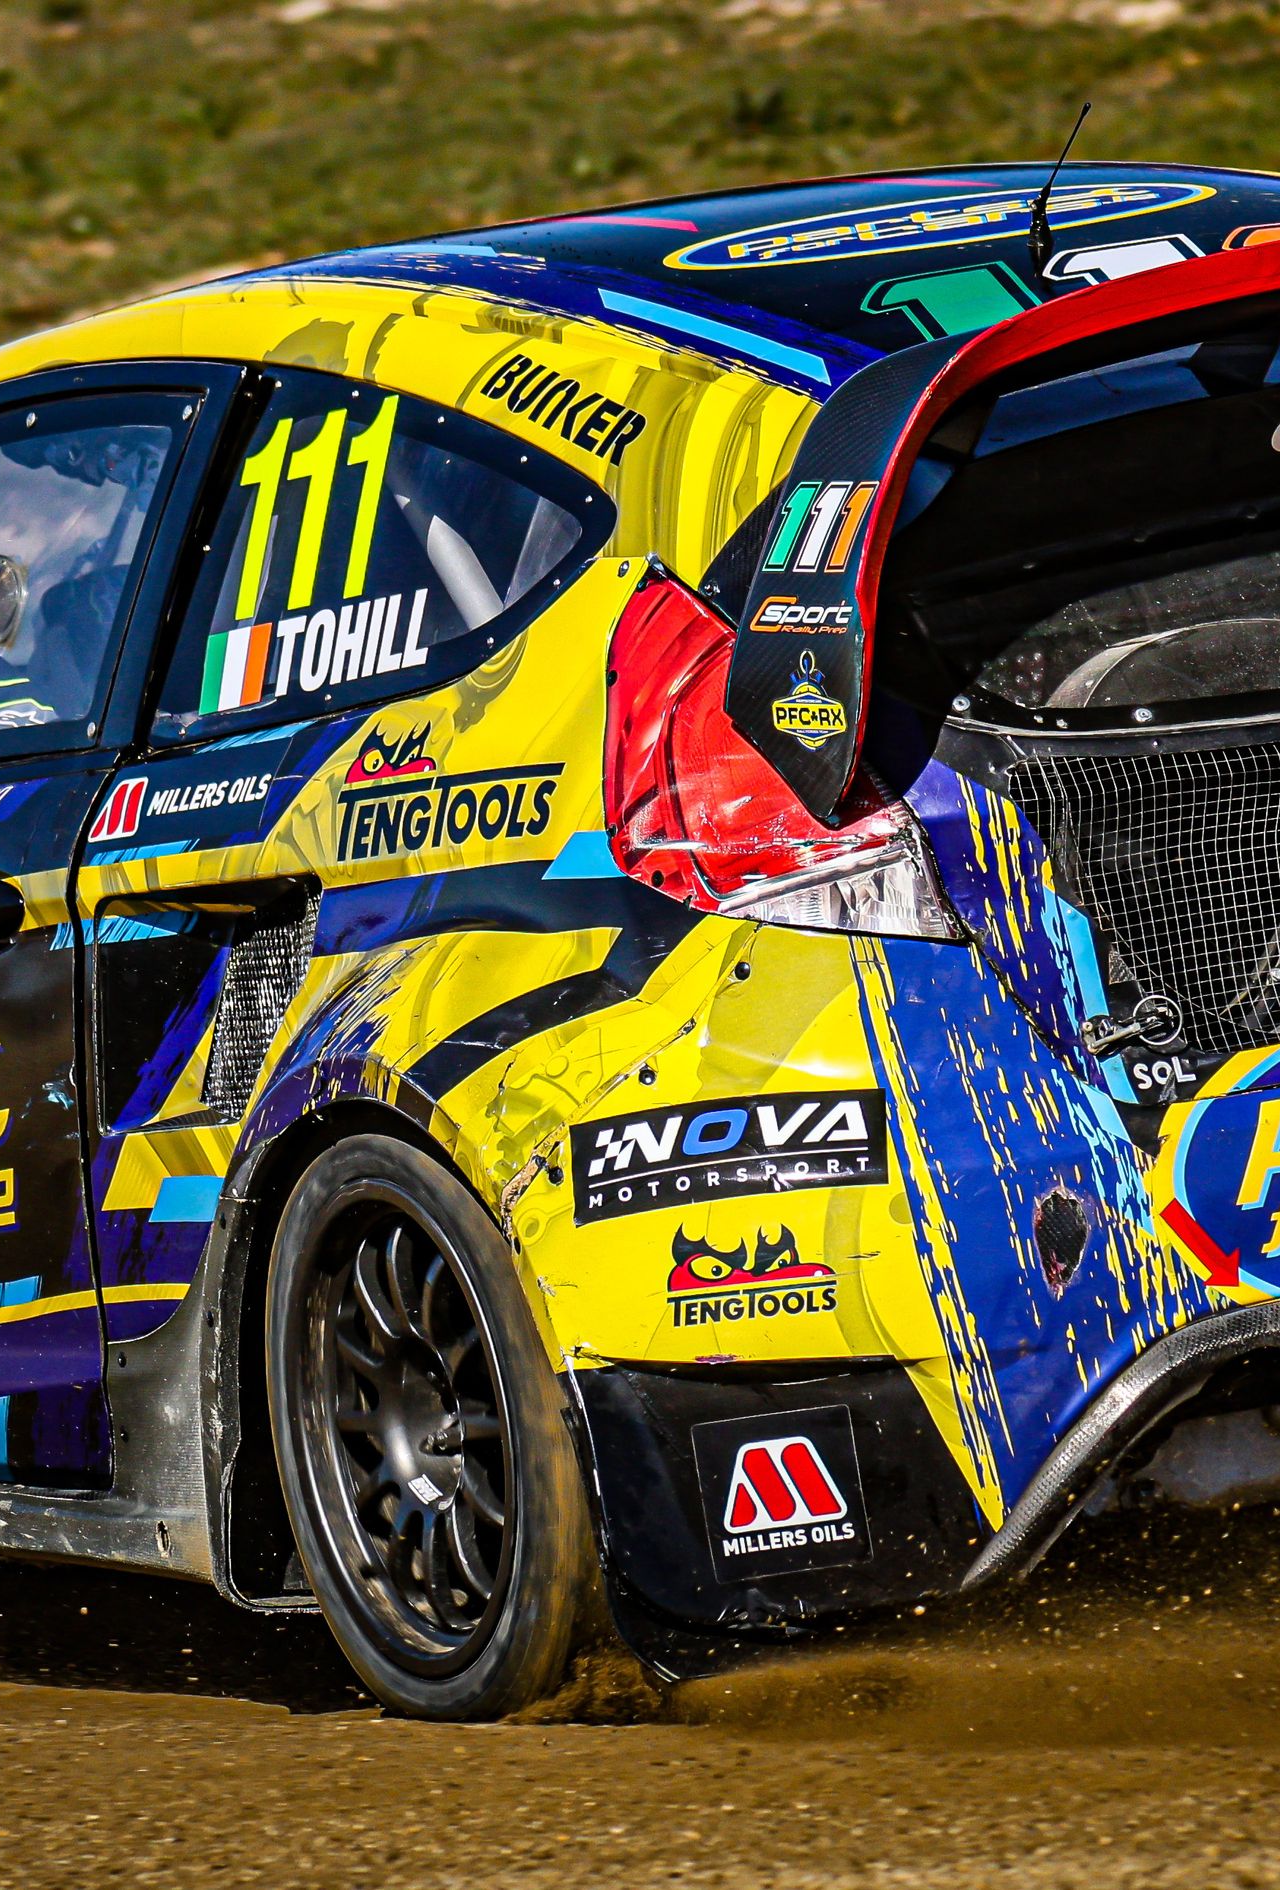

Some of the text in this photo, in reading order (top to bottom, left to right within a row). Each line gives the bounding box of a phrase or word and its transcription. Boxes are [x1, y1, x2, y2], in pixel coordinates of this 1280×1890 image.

[480, 354, 647, 467] BUNKER
[235, 395, 399, 621] 111
[762, 481, 880, 573] 111
[274, 588, 429, 698] TOHILL
[781, 625, 848, 634] Rally Prep
[146, 779, 228, 817] MILLERS
[228, 773, 272, 803] OILS
[1132, 1055, 1197, 1091] SOL
[587, 1100, 869, 1177] NOVA
[588, 1157, 870, 1209] MOTORSPORT
[722, 1522, 856, 1557] MILLERS OILS
